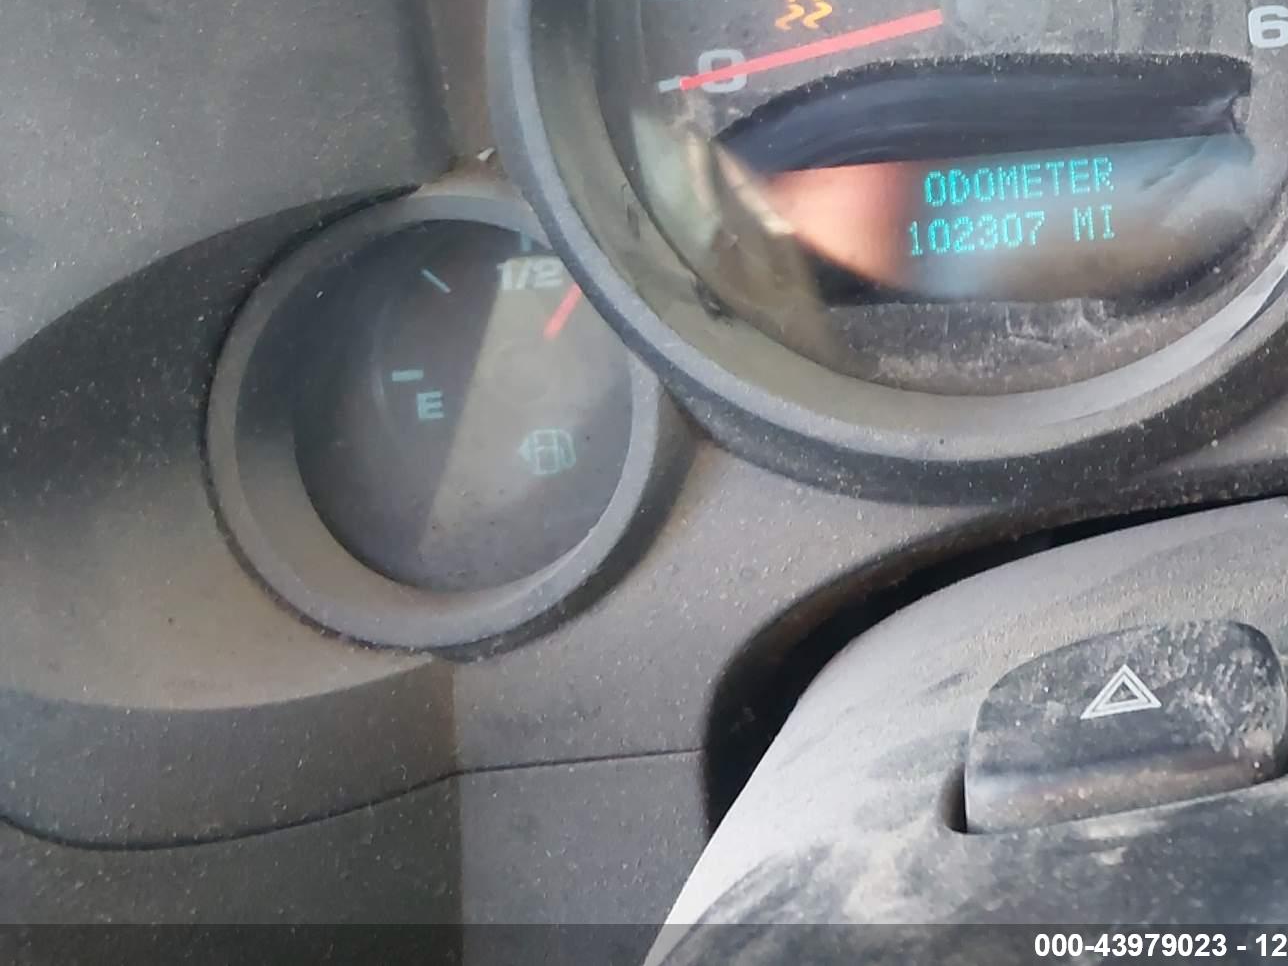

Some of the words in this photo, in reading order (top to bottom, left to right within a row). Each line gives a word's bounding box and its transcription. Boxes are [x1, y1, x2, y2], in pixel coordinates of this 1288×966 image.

[697, 49, 747, 93] 0
[924, 157, 1114, 207] ODOMETER
[909, 210, 1045, 256] 102307
[1072, 204, 1116, 242] MI
[416, 391, 444, 420] E
